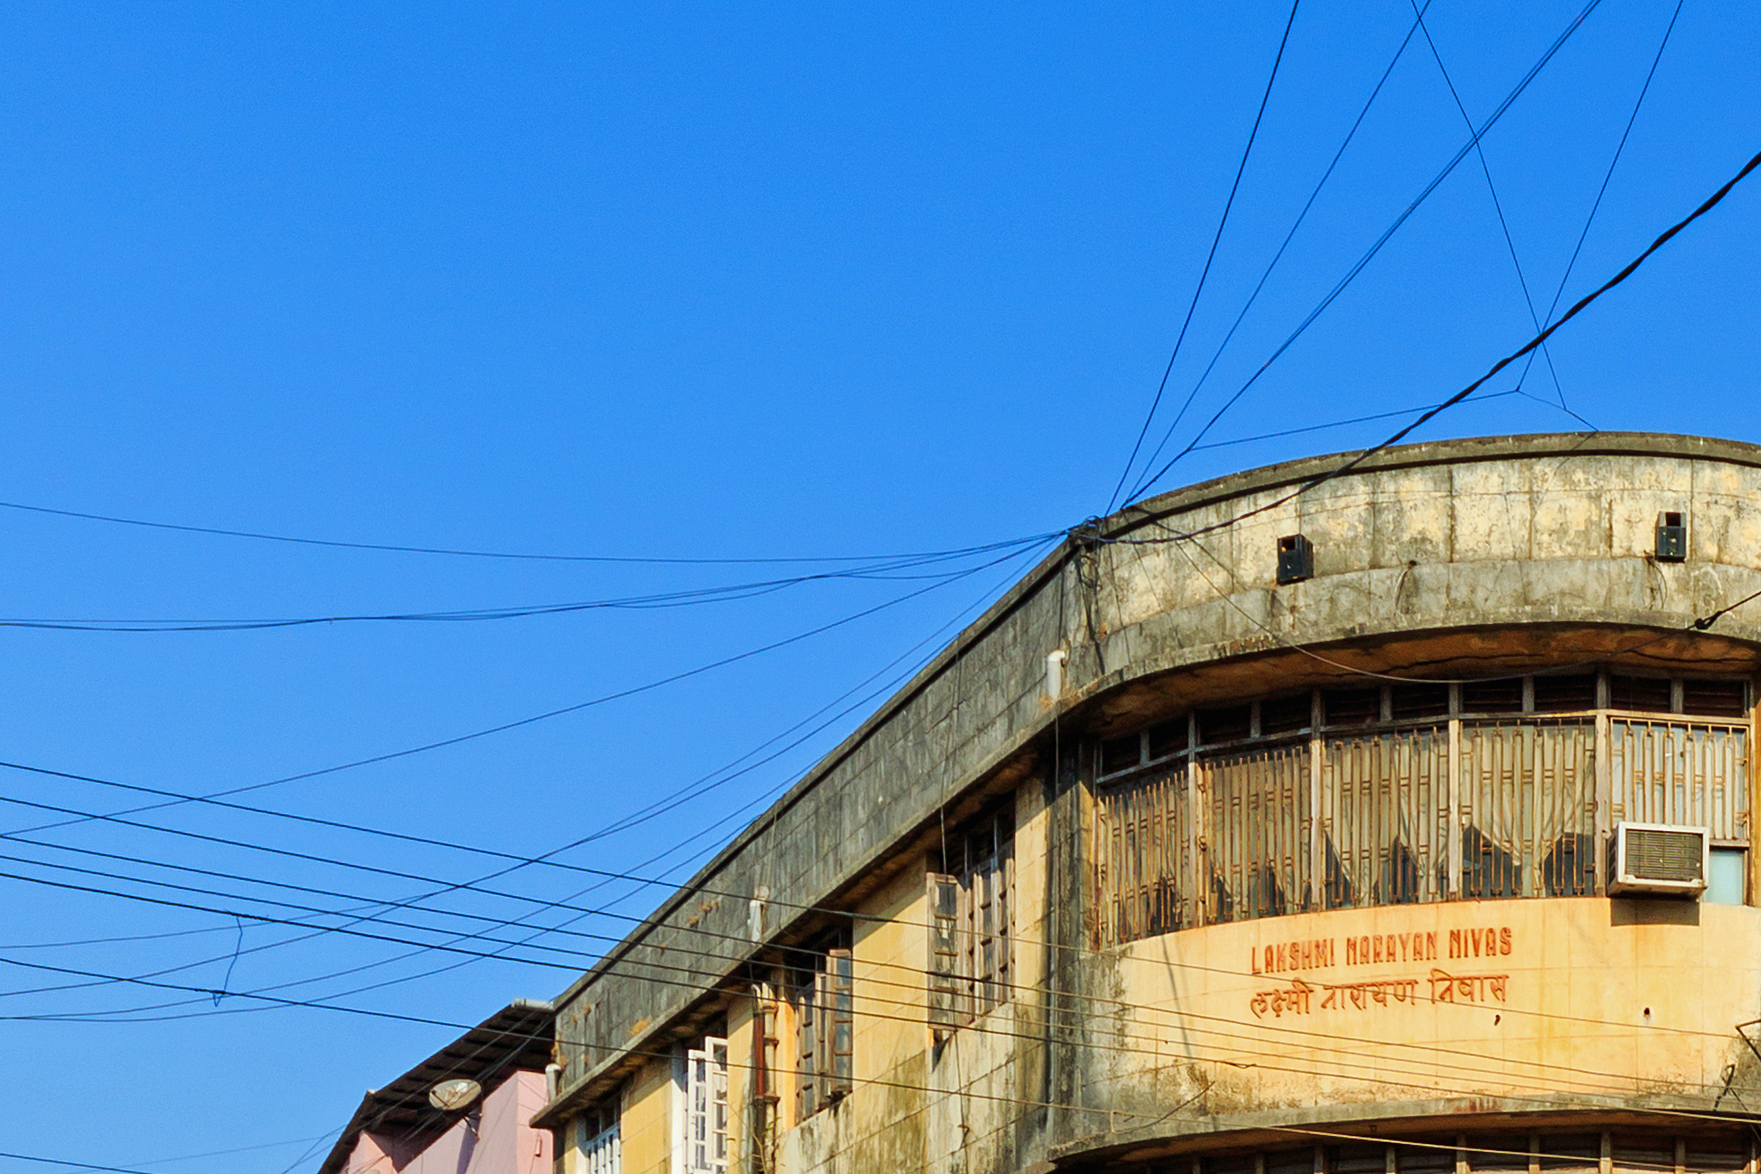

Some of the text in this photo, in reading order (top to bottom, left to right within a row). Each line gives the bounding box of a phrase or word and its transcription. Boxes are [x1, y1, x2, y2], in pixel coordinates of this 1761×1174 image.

[1251, 927, 1512, 975] LAKSHMI NARAYAN NIVAS
[1321, 979, 1419, 1011] नारायण
[1427, 968, 1510, 1004] निवास
